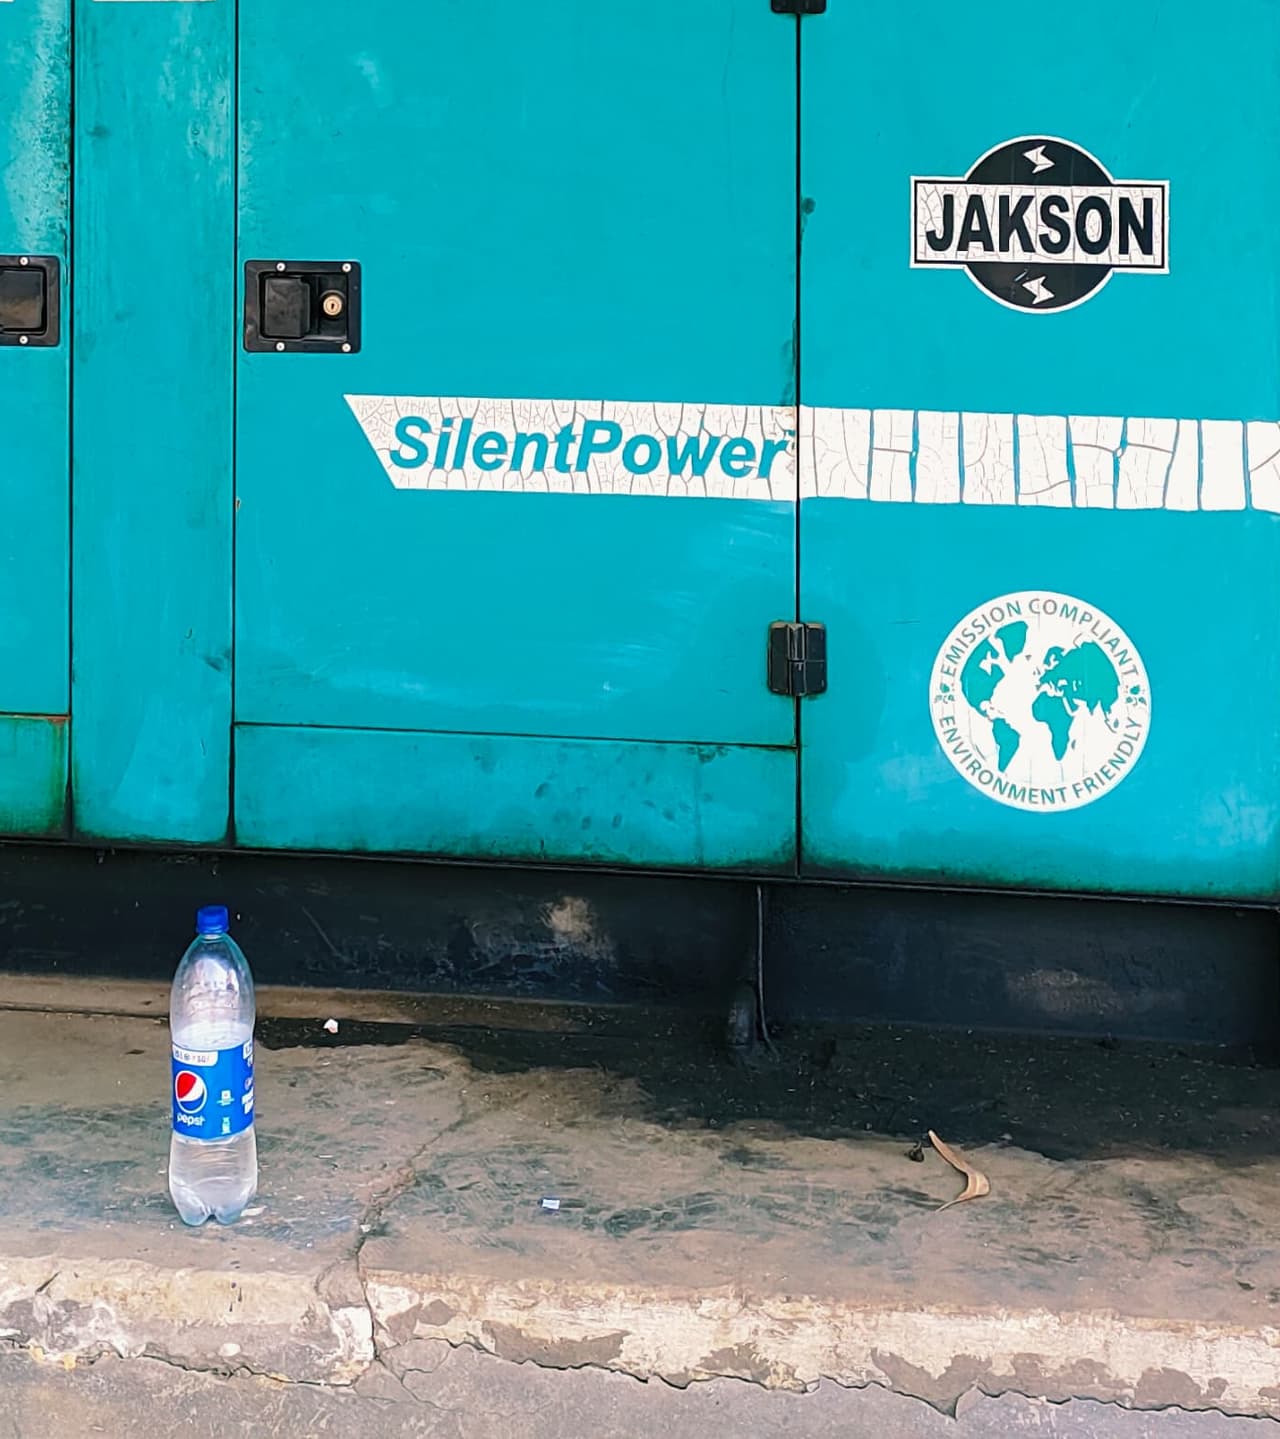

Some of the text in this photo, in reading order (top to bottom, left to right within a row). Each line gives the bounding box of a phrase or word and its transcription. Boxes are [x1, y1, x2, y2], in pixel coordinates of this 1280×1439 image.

[925, 193, 1154, 257] JAKSON
[389, 415, 790, 480] SilentPower
[940, 597, 1139, 679] EMISSION COMPLIANT
[938, 714, 1143, 806] ENVIRONMENT FRIENDLY
